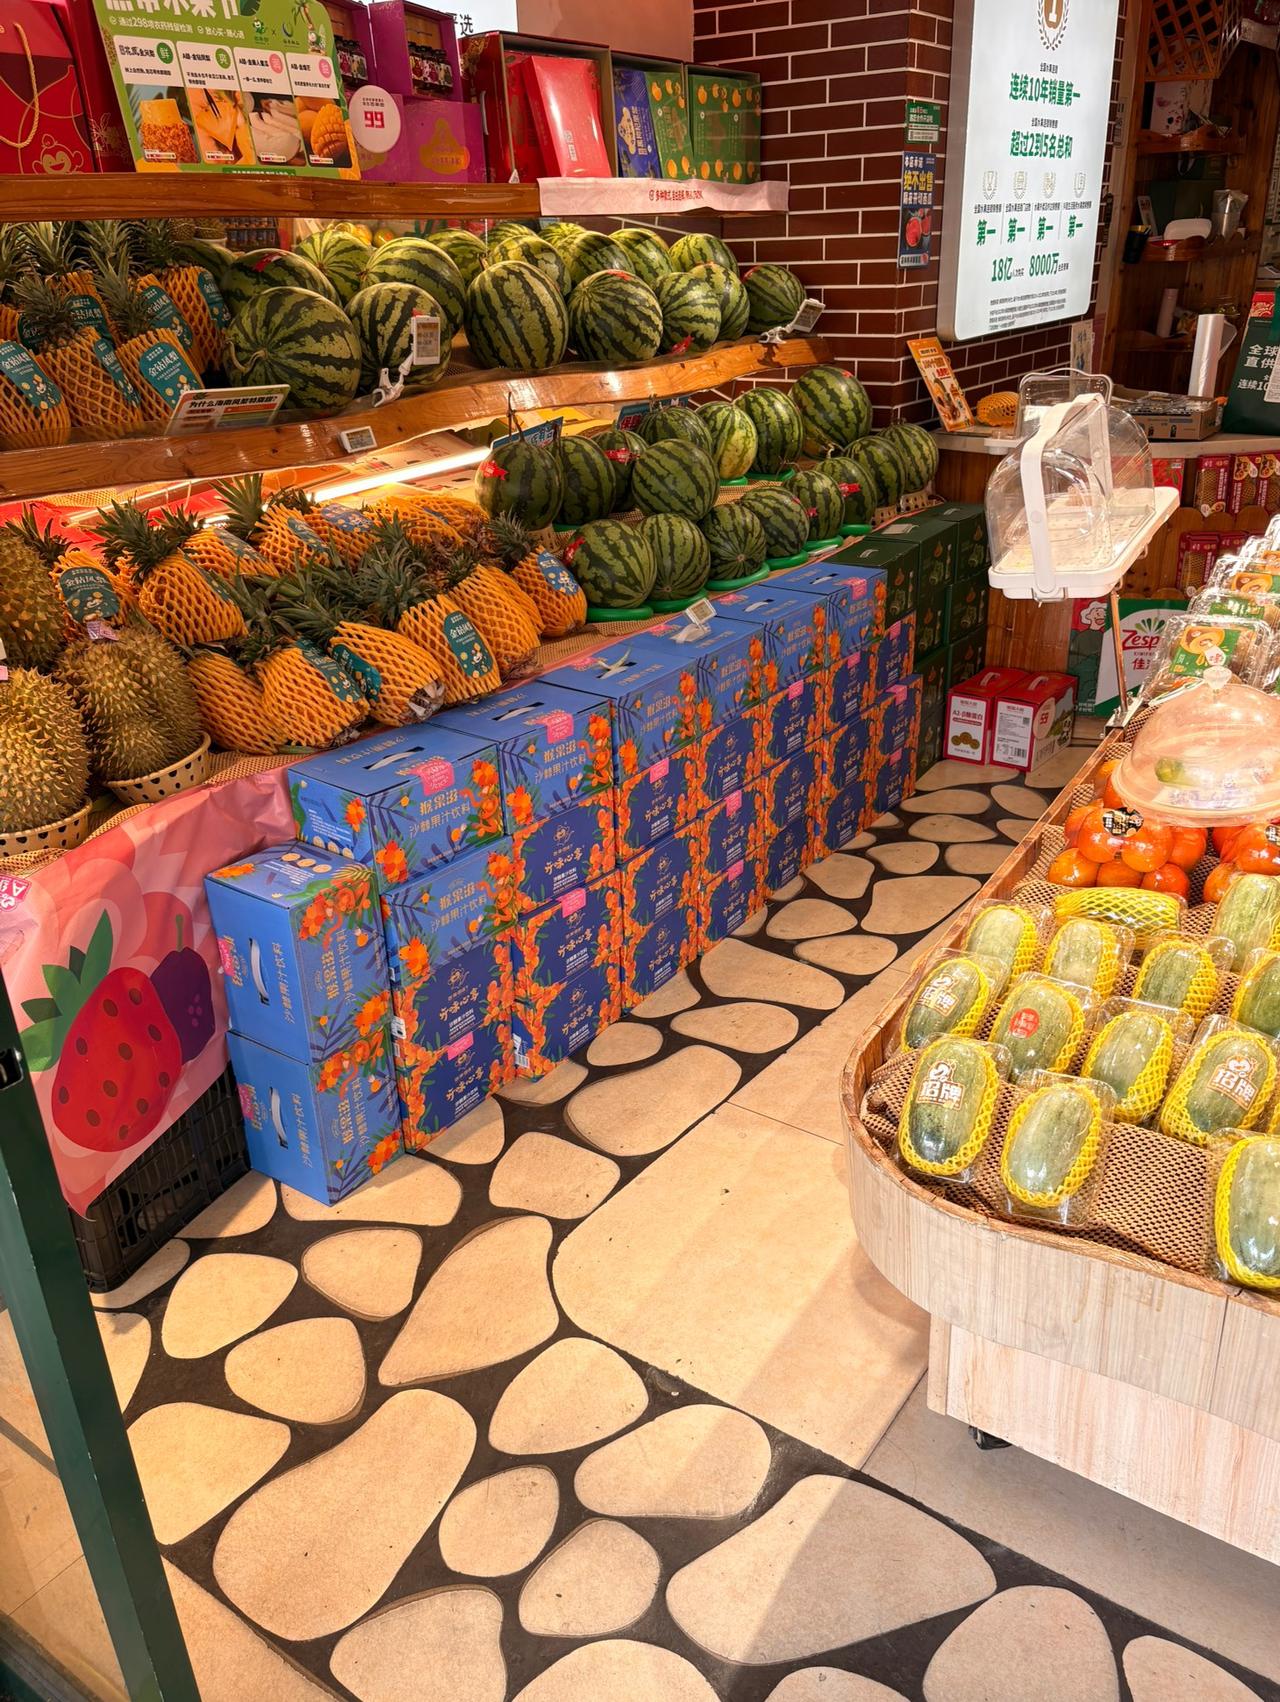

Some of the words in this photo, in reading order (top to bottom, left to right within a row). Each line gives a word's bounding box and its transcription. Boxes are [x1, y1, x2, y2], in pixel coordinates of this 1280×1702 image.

[1008, 72, 1081, 107] 连续10年销量第一
[364, 111, 385, 129] 99
[1009, 129, 1073, 159] 超过2到5名总和
[903, 171, 934, 193] 绝不出售
[976, 219, 996, 246] 第一
[1007, 217, 1026, 243] 第一
[1036, 215, 1054, 241] 第一
[1067, 214, 1084, 239] 第一
[991, 256, 1014, 282] 18亿
[1028, 252, 1060, 278] 8000万
[1243, 356, 1275, 369] 直供
[1248, 344, 1279, 357] 全球
[919, 1079, 962, 1104] 招牌
[1213, 1067, 1256, 1102] 招牌
